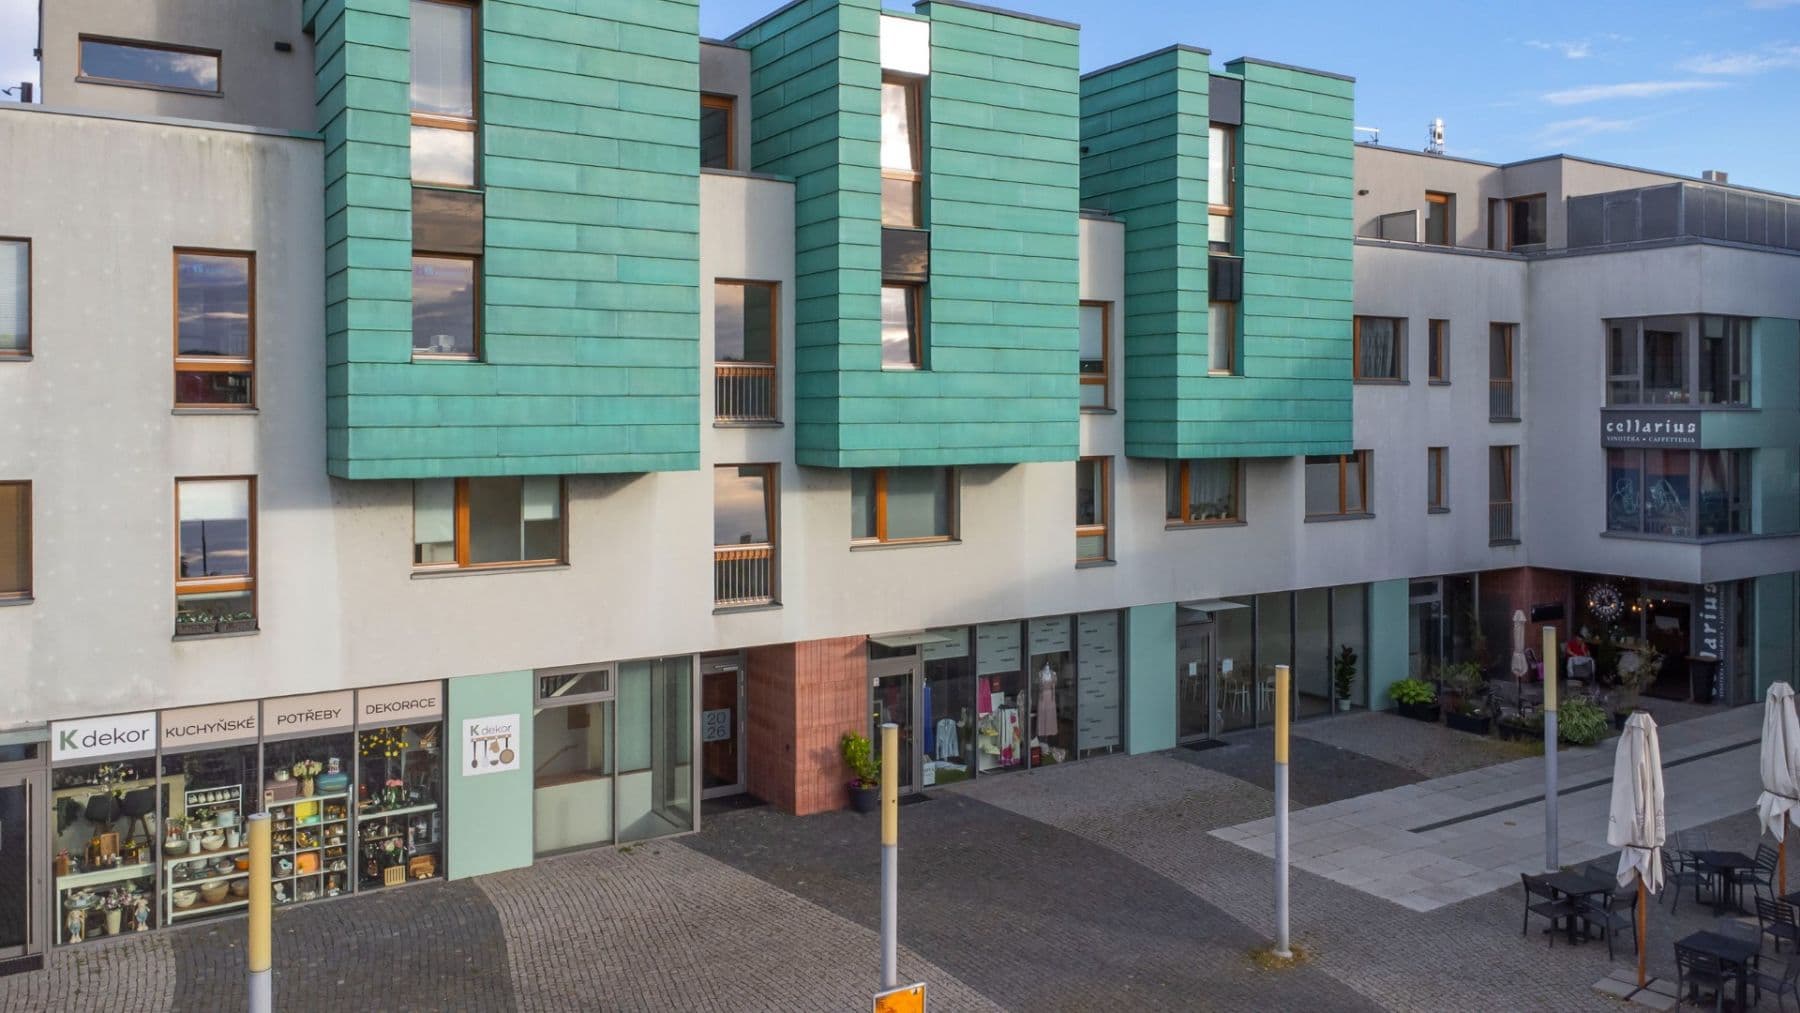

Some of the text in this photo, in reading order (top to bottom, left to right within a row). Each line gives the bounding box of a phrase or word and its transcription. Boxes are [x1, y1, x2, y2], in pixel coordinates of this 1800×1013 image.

[1606, 419, 1696, 433] cellarius
[1700, 584, 1717, 696] larius
[366, 697, 436, 715] DEKORACE
[277, 708, 342, 725] POTŘEBY
[707, 711, 726, 726] 20
[166, 716, 255, 738] KUCHYŇSKÉ
[470, 724, 480, 736] K
[707, 725, 726, 739] 26
[60, 727, 150, 751] K dekor
